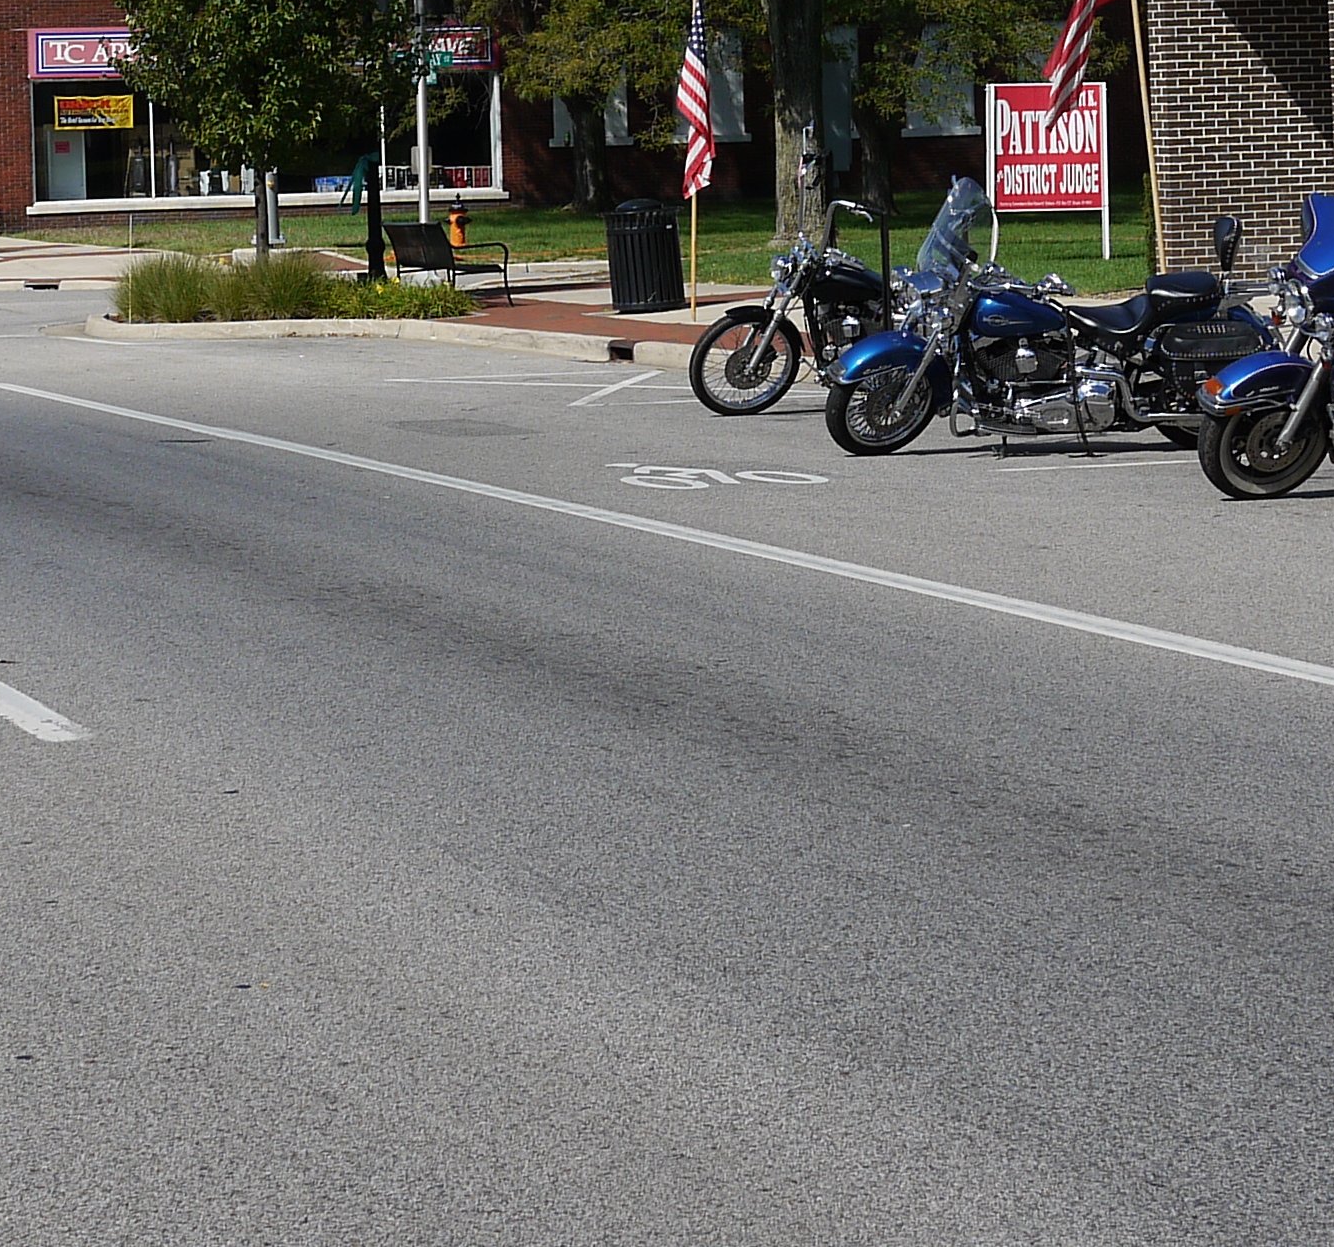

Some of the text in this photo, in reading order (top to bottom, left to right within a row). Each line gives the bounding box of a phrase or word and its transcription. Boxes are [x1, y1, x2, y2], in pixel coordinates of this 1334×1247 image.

[49, 42, 85, 64] TC
[1003, 164, 1058, 195] DISTRICT
[1059, 163, 1099, 194] JUDGE
